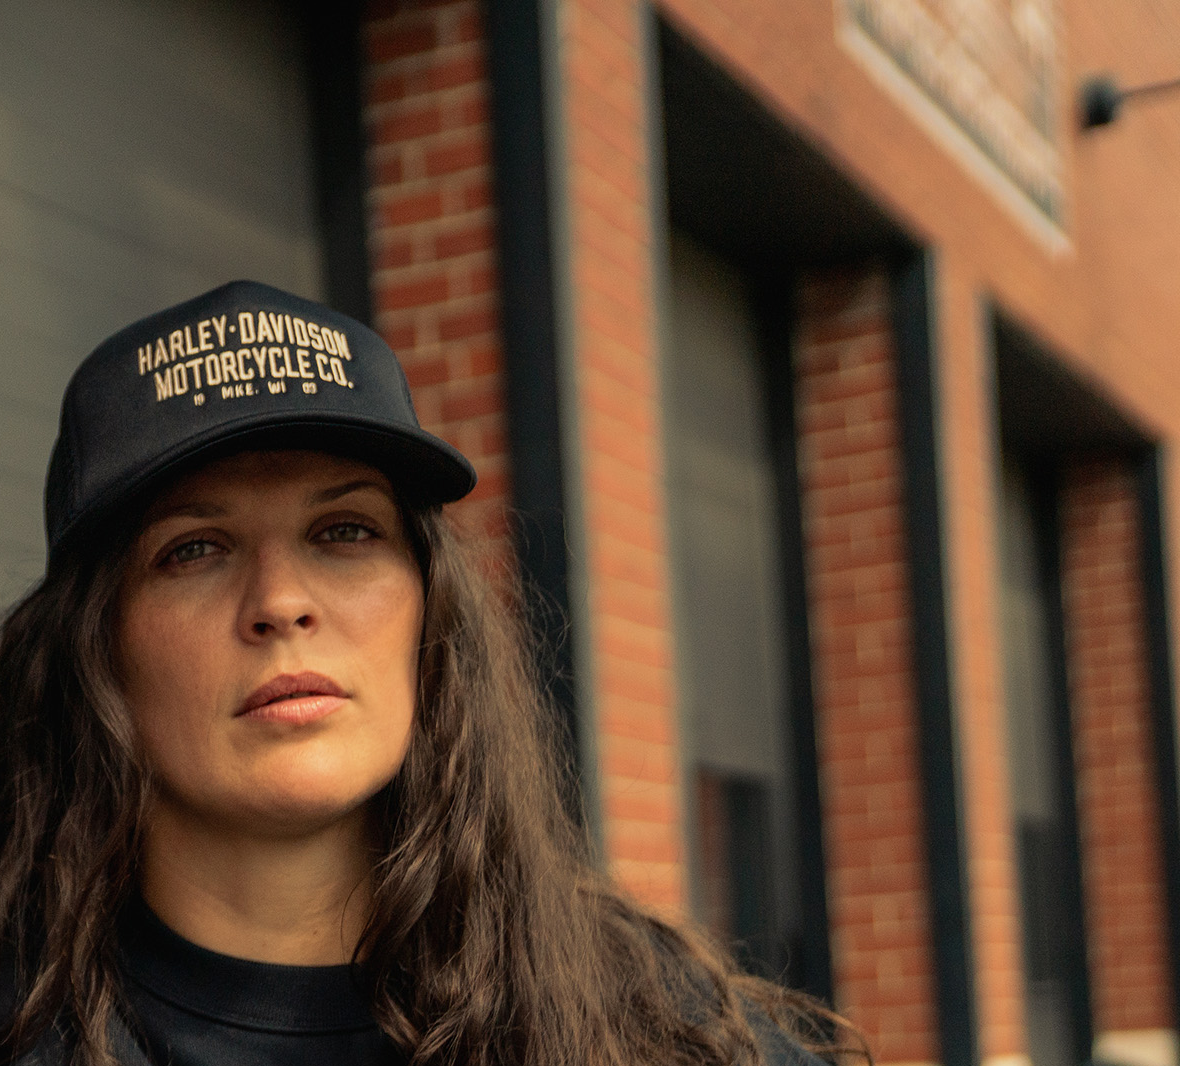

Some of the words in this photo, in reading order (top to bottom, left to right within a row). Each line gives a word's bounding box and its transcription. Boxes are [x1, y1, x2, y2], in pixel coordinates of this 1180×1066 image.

[154, 346, 315, 401] MOTORCYCLE
[315, 353, 354, 389] CO.
[221, 381, 260, 400] MKE.
[268, 379, 287, 395] WI
